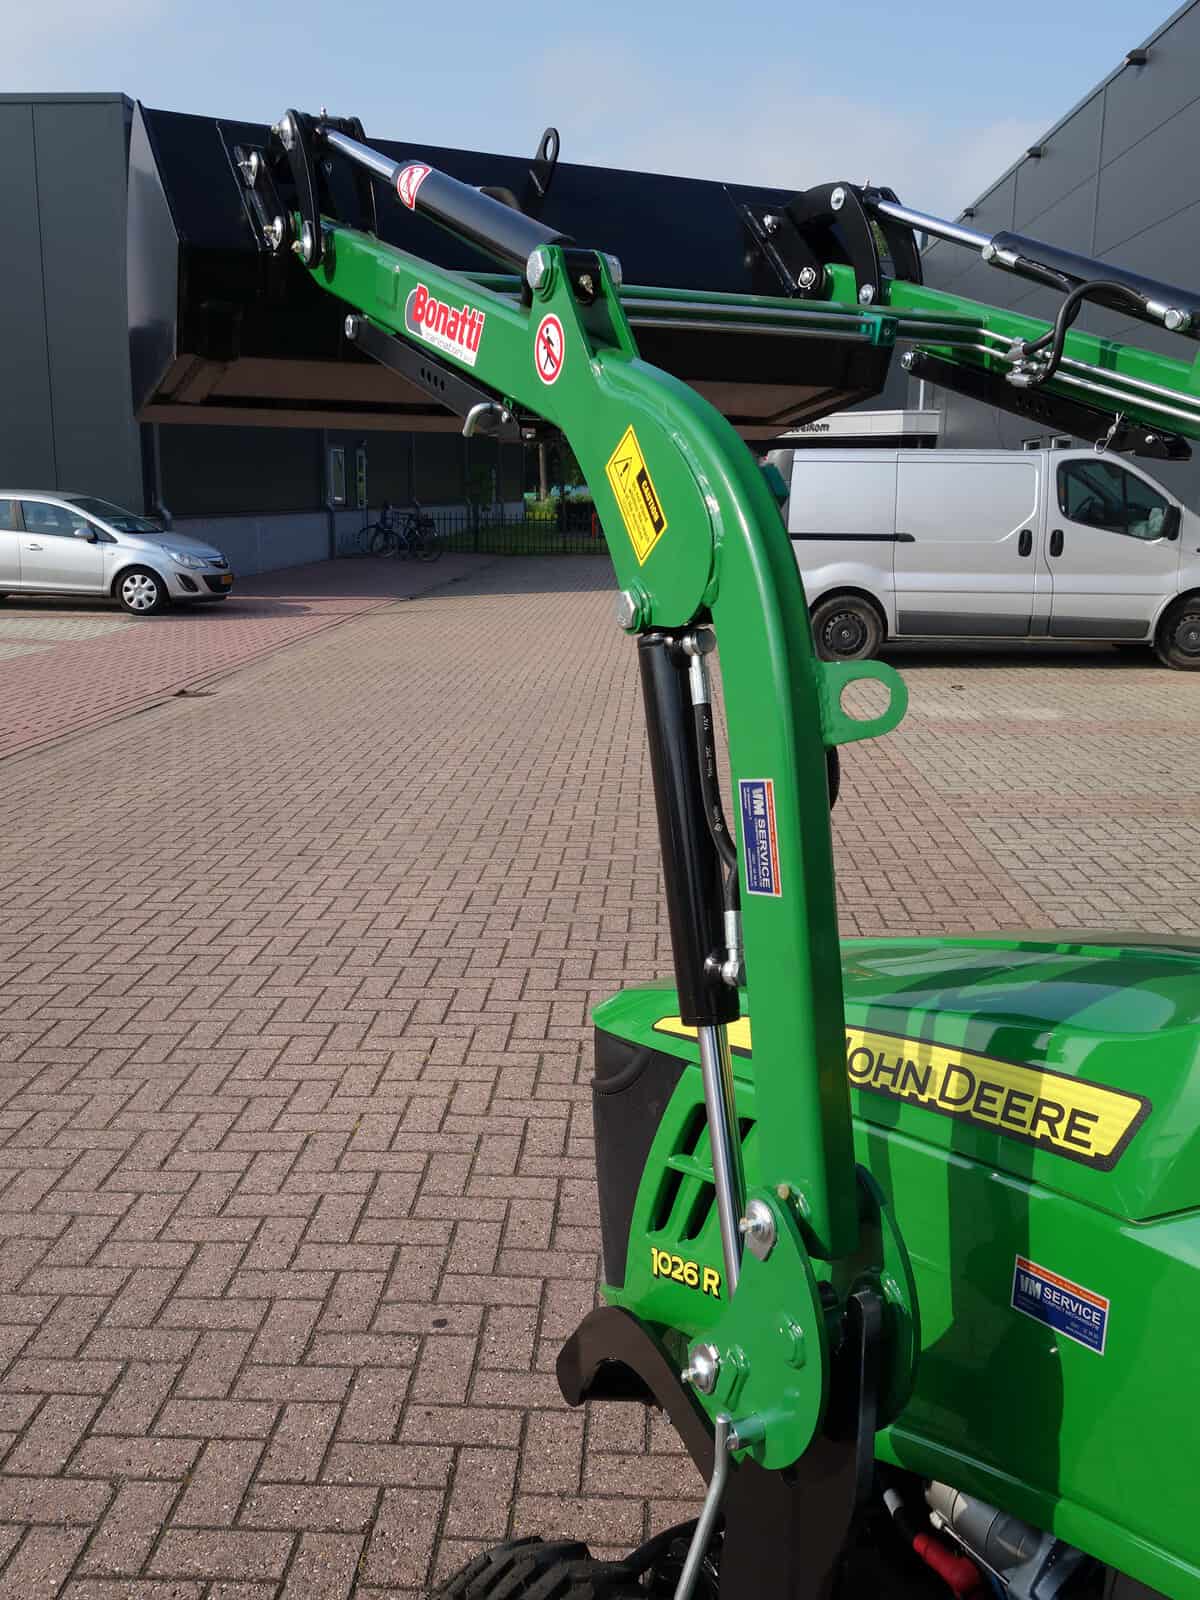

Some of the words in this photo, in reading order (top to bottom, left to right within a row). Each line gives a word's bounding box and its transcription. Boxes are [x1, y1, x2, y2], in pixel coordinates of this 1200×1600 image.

[412, 285, 484, 352] Bonatti
[641, 480, 660, 523] CAUTION
[752, 787, 765, 816] VM
[758, 819, 771, 888] SERVICE
[939, 1064, 1099, 1149] DEERE
[651, 1247, 699, 1289] 1026
[703, 1266, 721, 1299] R
[1020, 1275, 1042, 1299] VM
[1043, 1287, 1101, 1326] SERVICE
